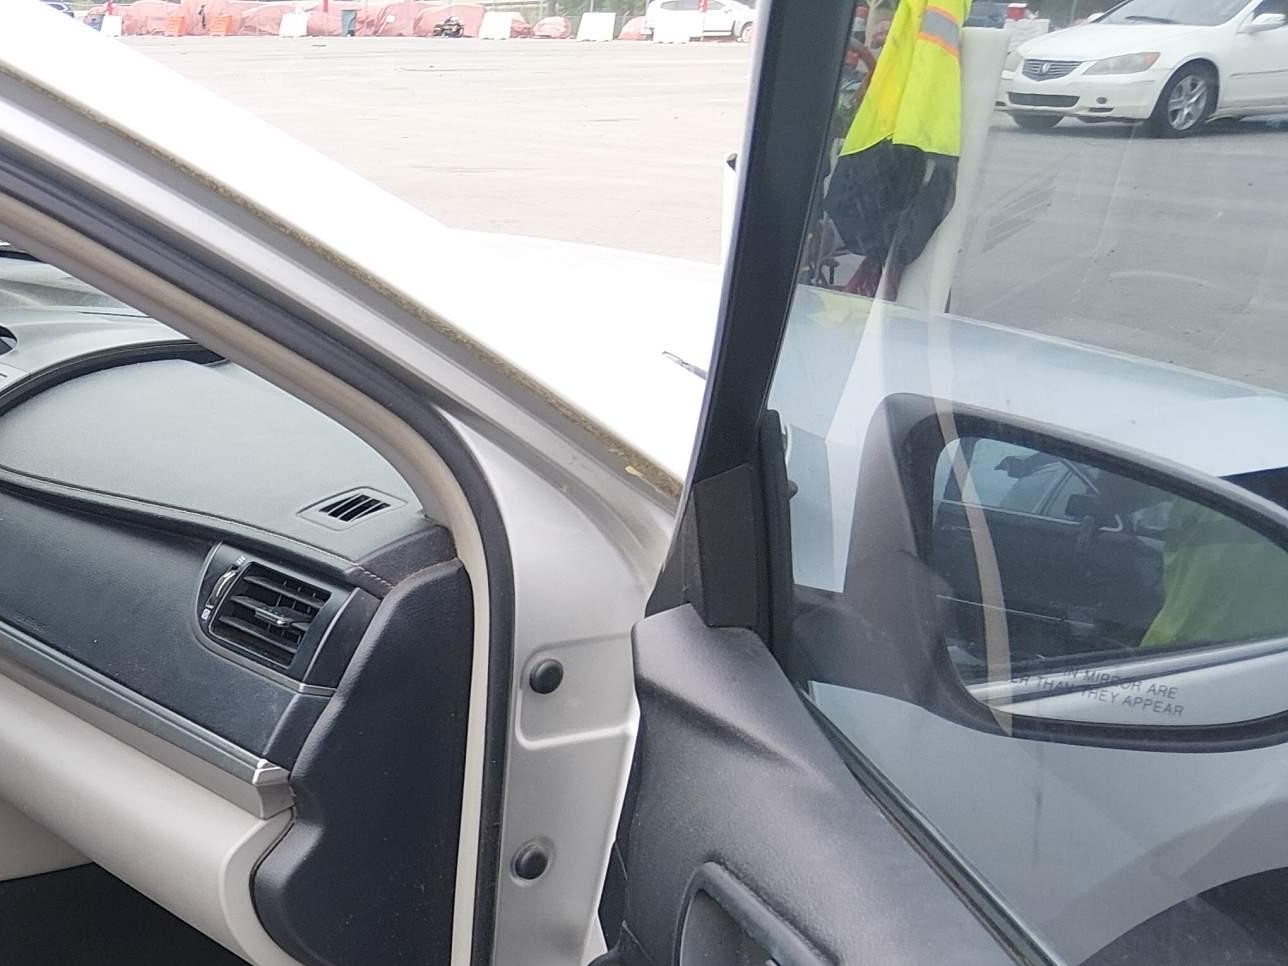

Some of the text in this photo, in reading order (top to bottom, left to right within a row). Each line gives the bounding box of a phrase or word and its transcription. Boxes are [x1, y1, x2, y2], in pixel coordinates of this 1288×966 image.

[1079, 687, 1119, 704] THEY
[1121, 695, 1185, 717] APPEAR
[1147, 682, 1179, 700] ARE
